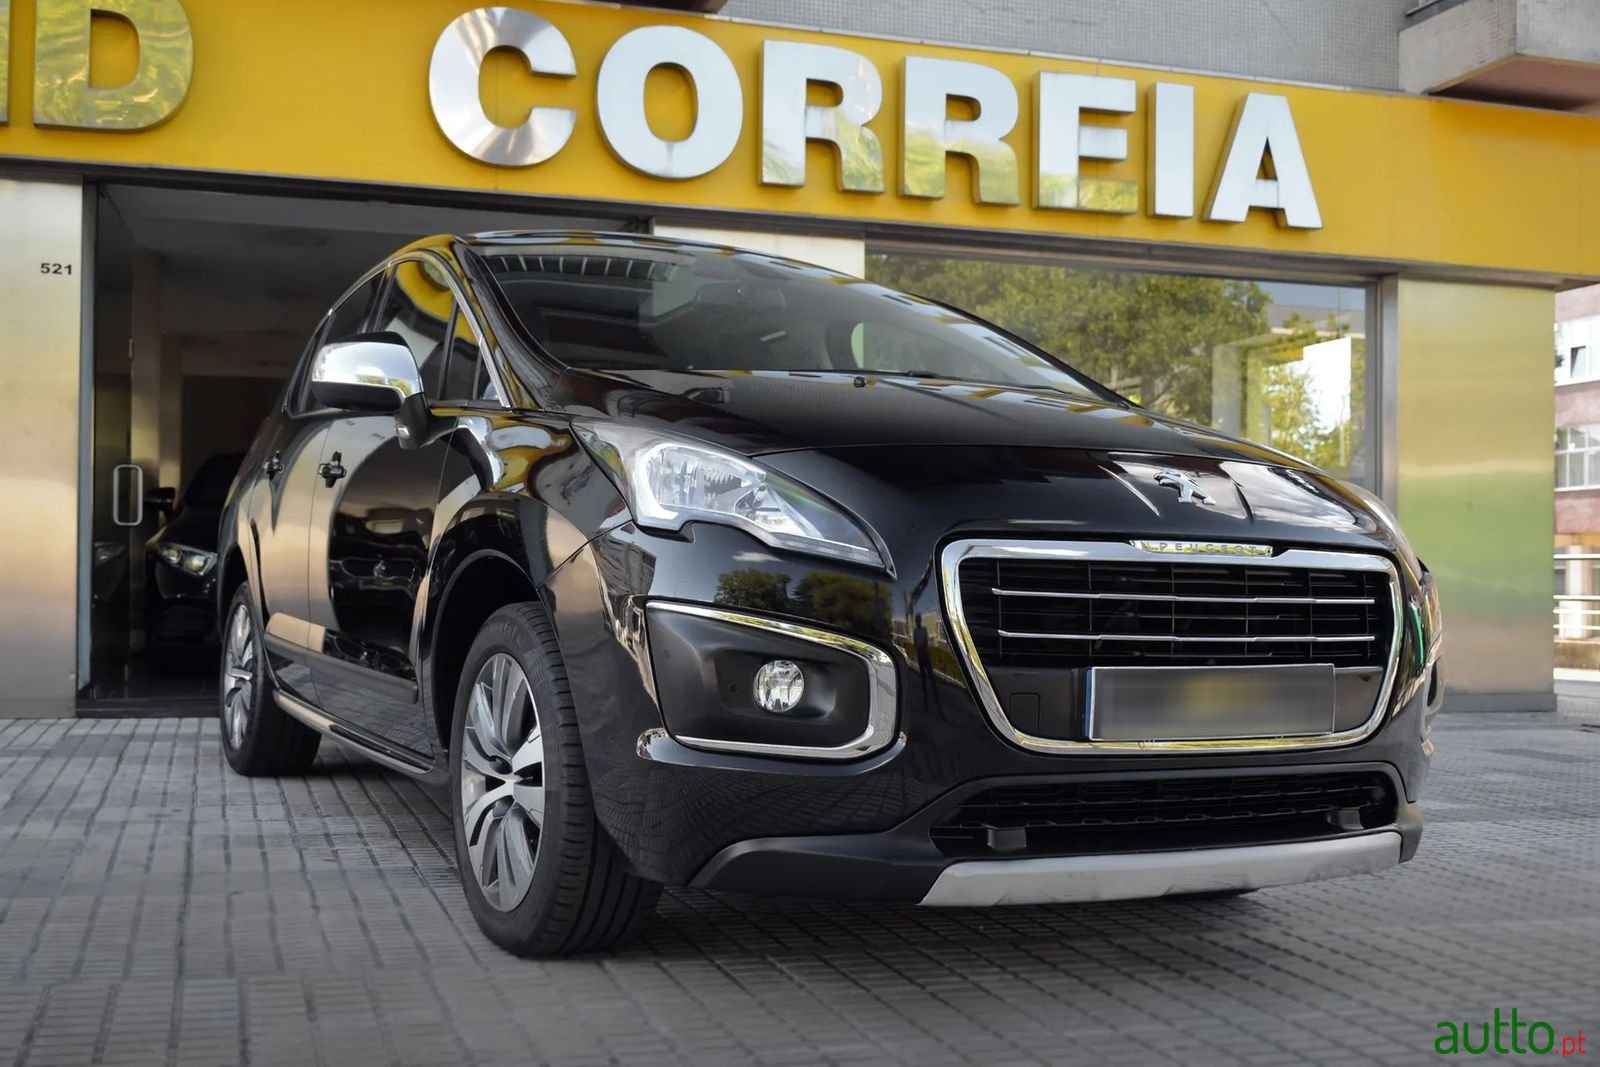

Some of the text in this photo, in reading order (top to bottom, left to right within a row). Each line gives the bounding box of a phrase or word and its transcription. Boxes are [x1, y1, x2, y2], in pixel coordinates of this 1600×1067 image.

[0, 0, 1322, 229] D CORREIA
[40, 262, 73, 275] 521
[1159, 541, 1257, 555] PEUGEOT
